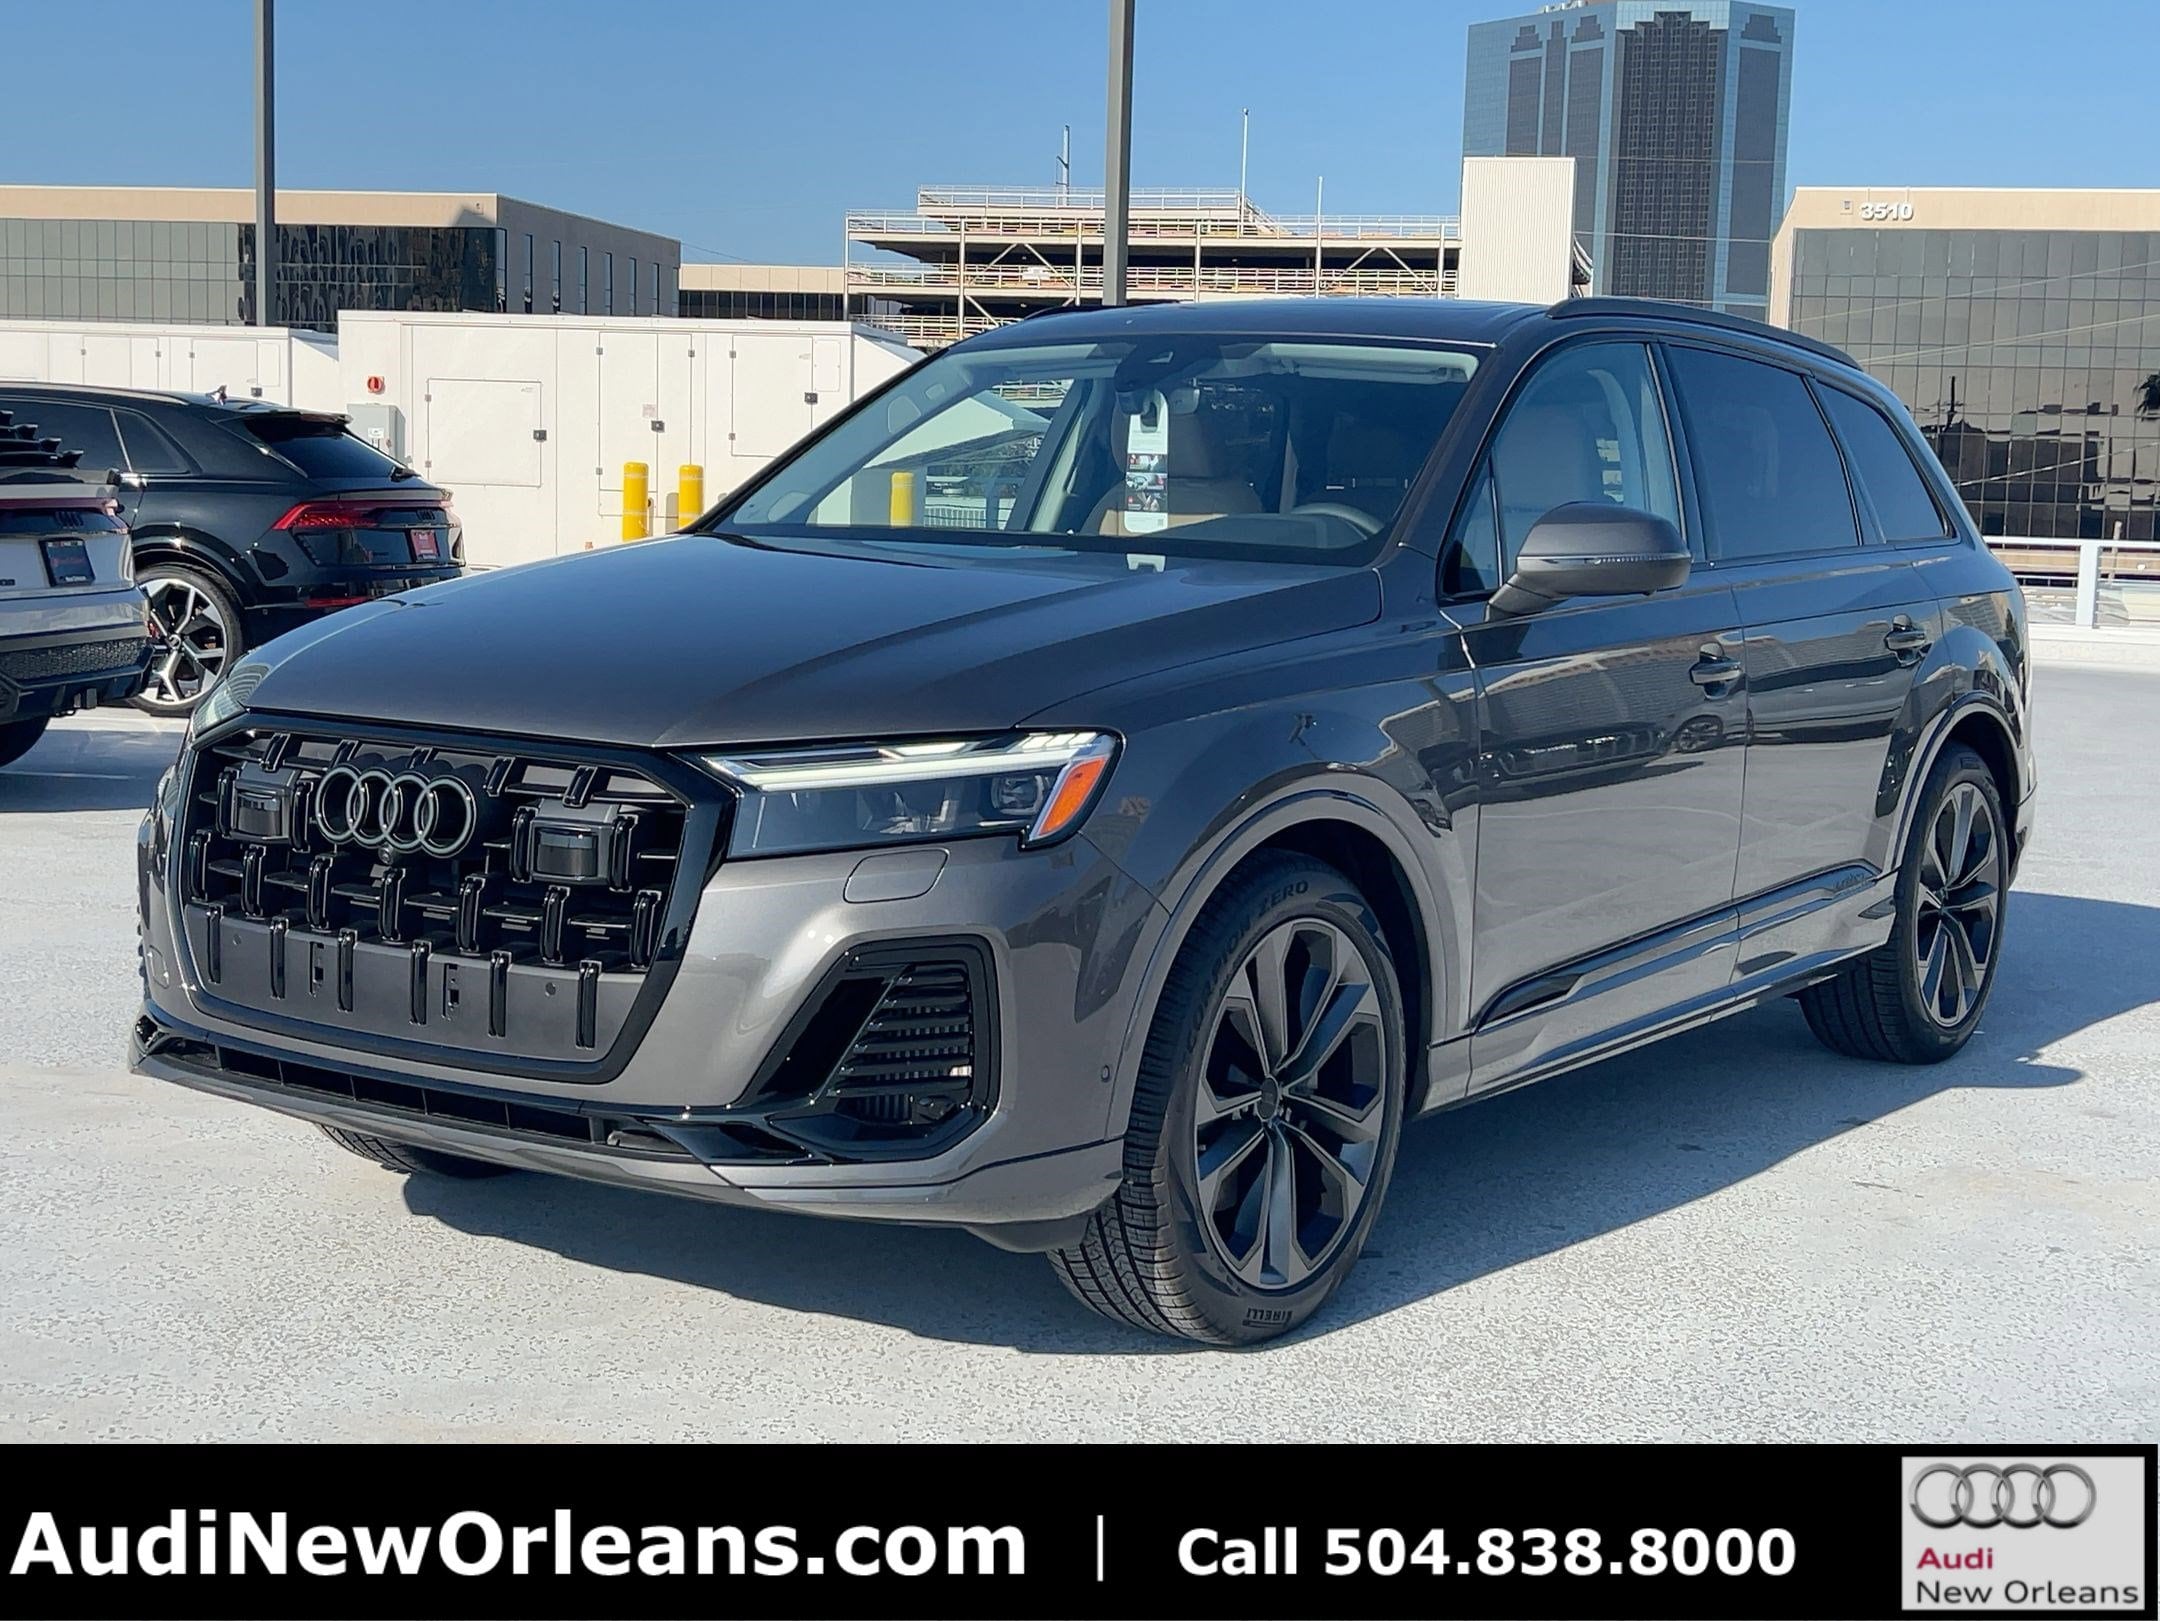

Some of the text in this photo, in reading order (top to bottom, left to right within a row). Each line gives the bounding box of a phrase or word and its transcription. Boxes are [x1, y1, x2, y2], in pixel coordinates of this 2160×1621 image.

[1860, 202, 1914, 221] 3510
[1259, 880, 1309, 917] ZERO
[1243, 1307, 1294, 1329] PIRELLI
